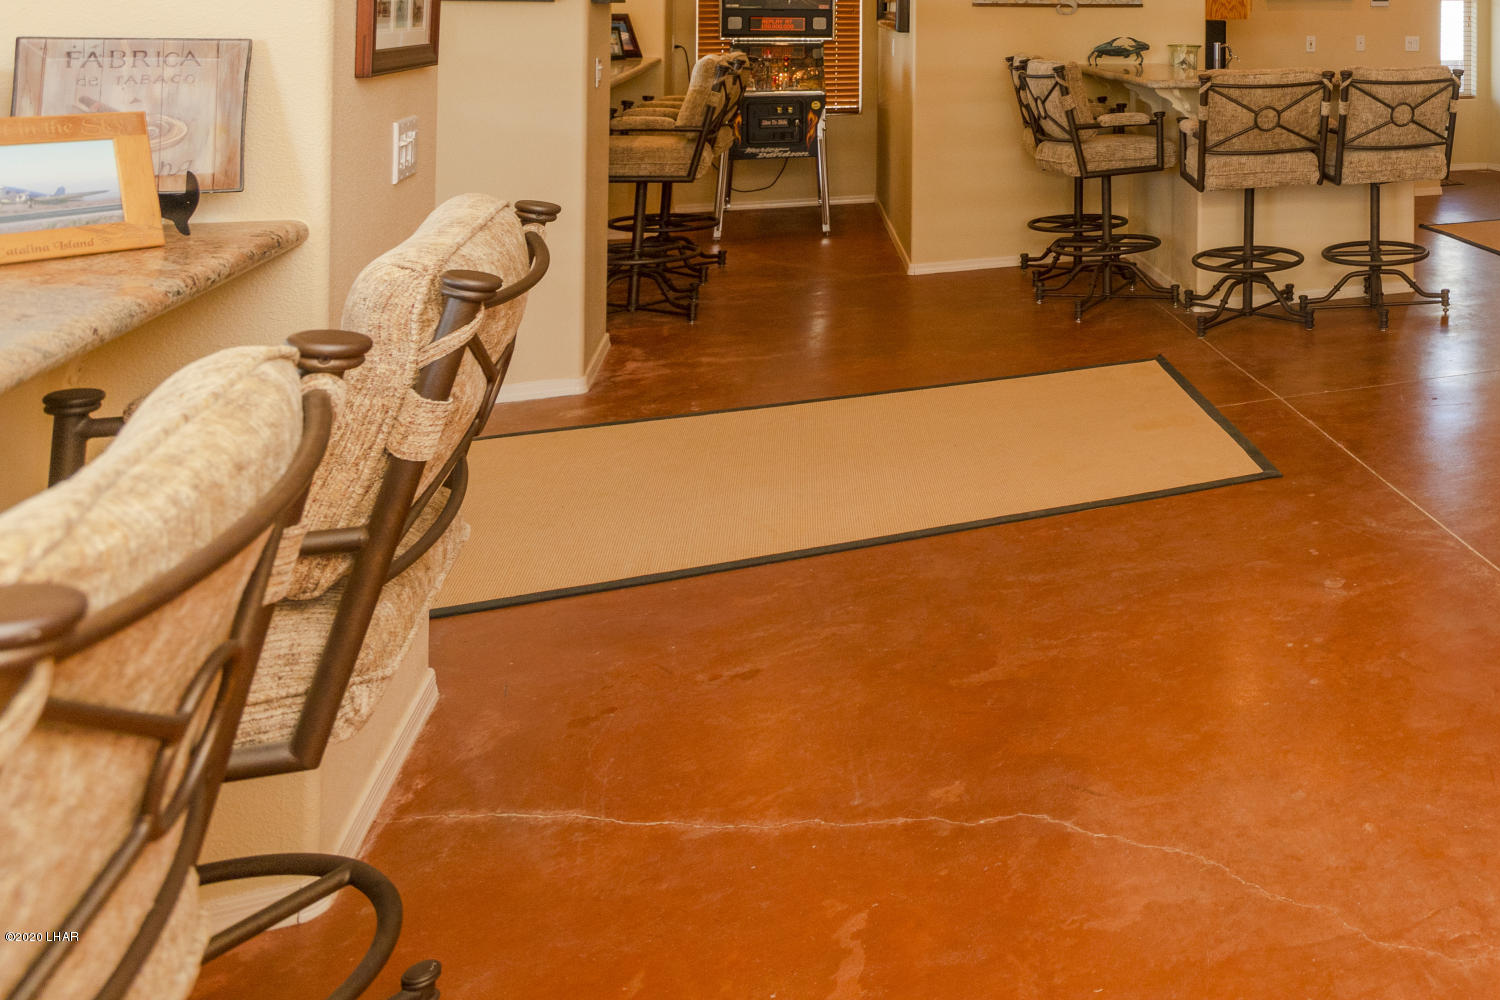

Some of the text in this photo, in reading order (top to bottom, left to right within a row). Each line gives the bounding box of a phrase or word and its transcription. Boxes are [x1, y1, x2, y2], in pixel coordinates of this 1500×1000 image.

[76, 73, 196, 87] de TABACO
[47, 120, 73, 135] the
[2, 238, 95, 257] atalina Island
